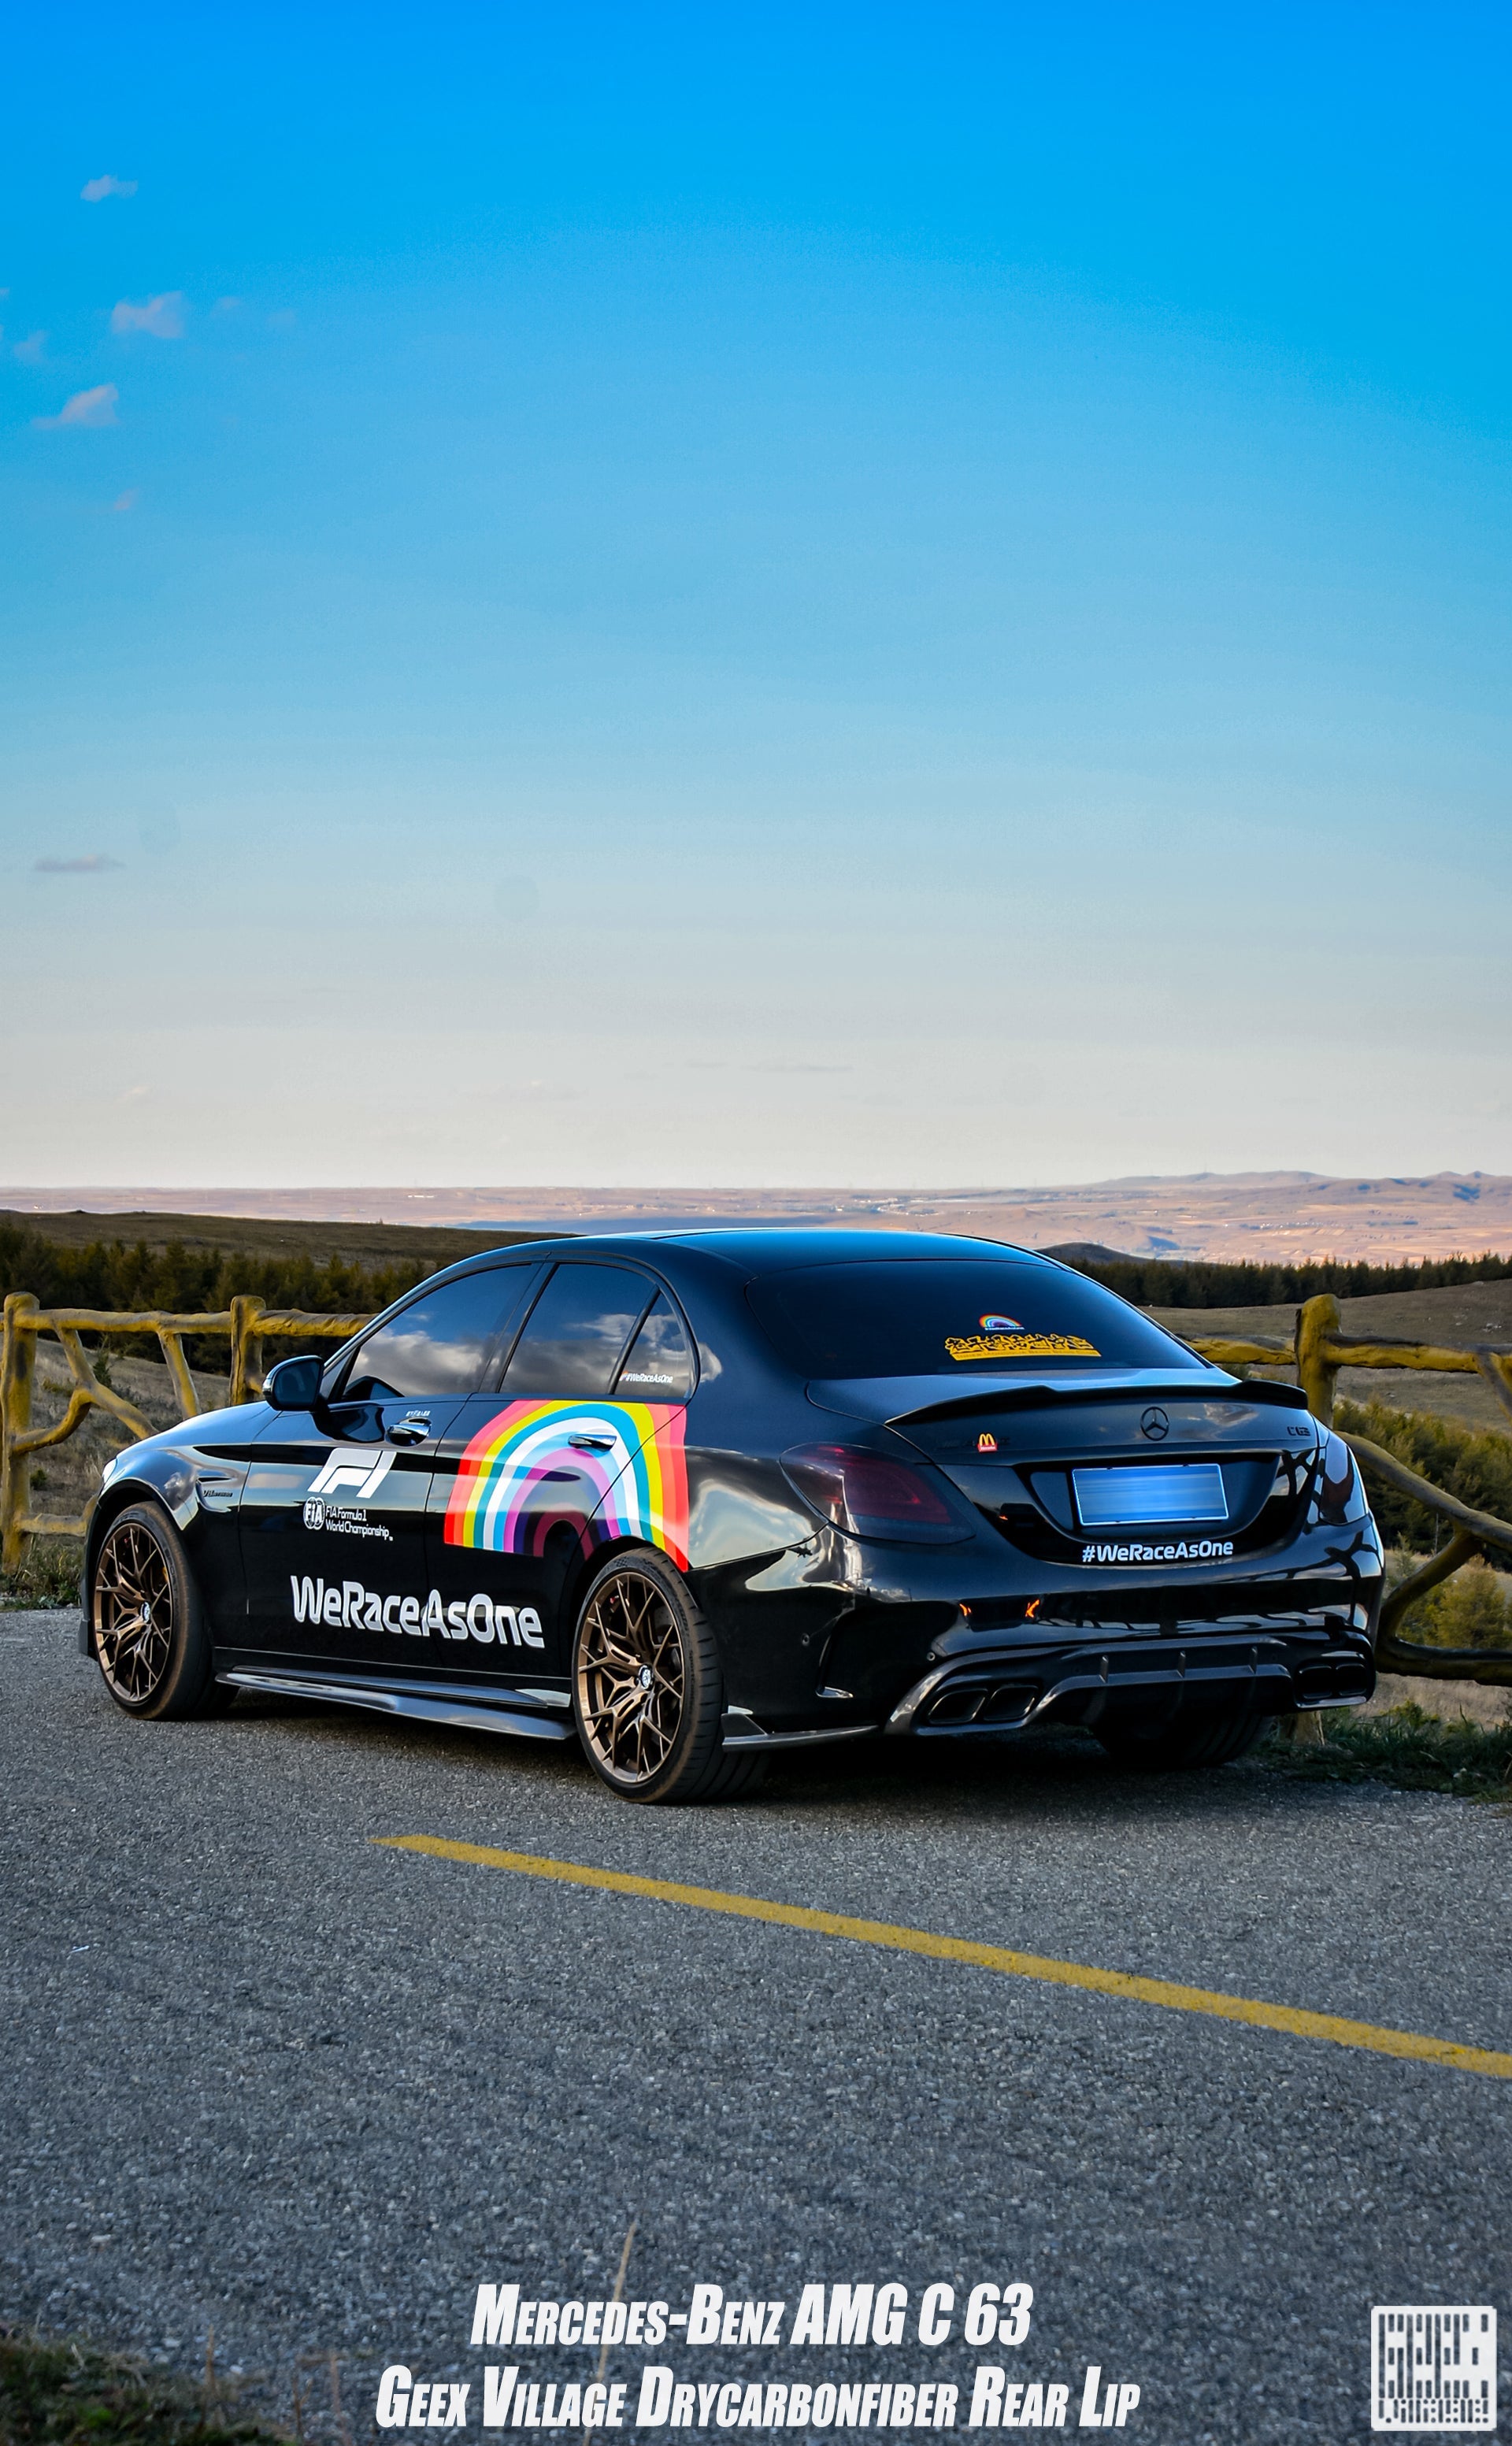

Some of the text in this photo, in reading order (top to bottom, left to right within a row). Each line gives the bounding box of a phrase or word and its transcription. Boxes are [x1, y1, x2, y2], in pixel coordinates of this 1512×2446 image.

[325, 1506, 368, 1521] FIA Formula 1
[325, 1518, 390, 1540] World Championship
[1082, 1540, 1234, 1563] #WeRaceAsOne
[290, 1575, 545, 1648] WeRaceAsOne
